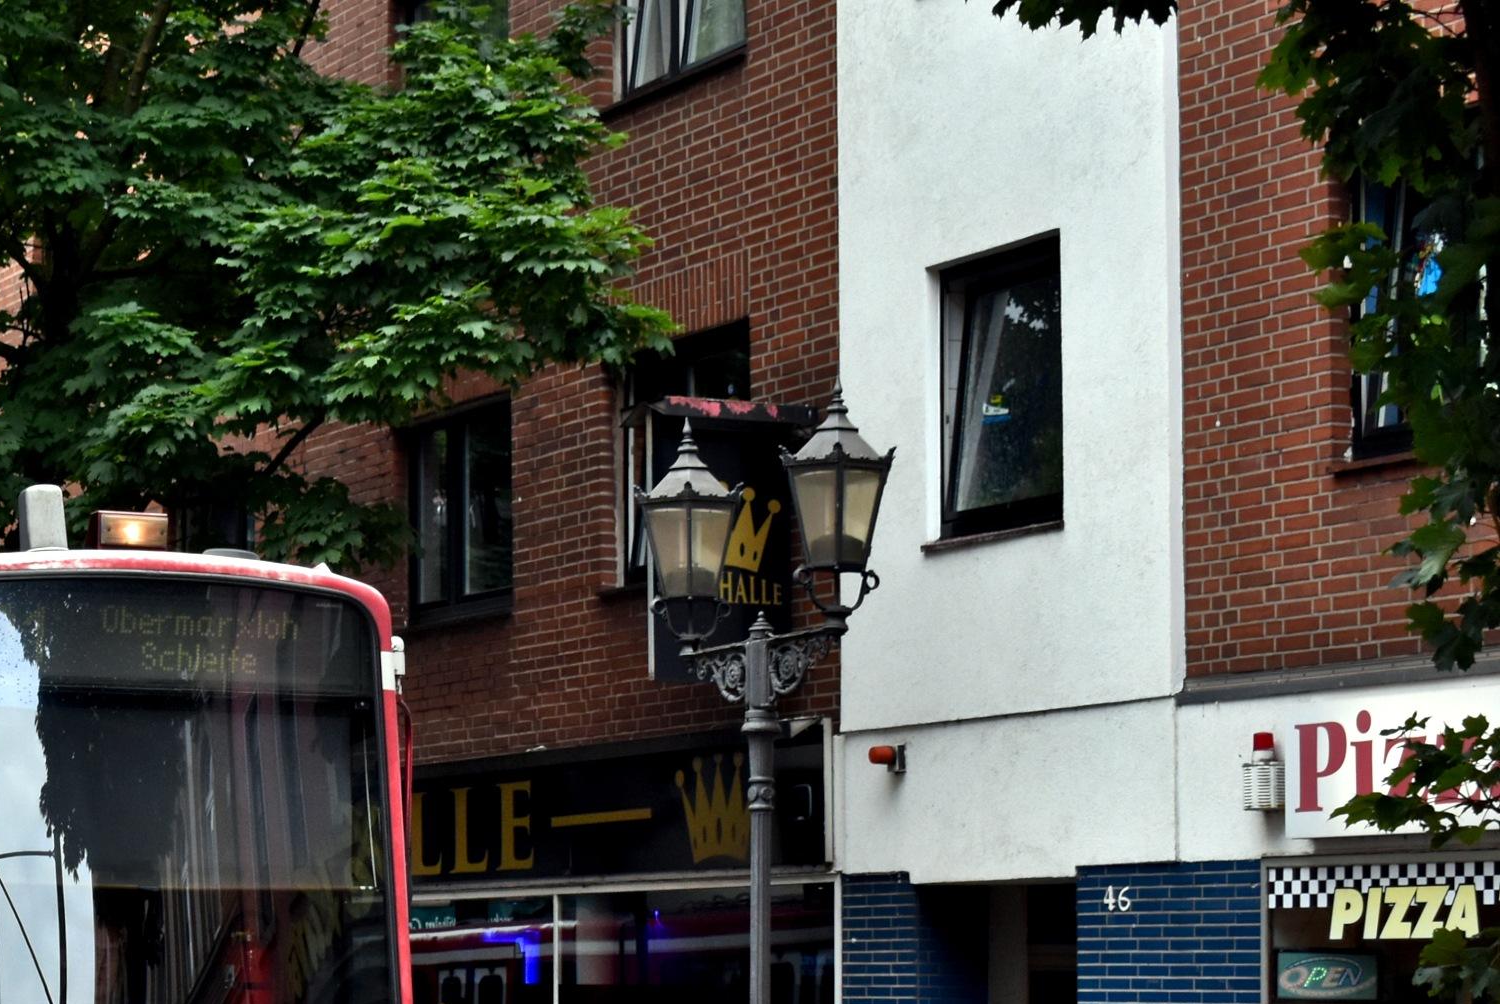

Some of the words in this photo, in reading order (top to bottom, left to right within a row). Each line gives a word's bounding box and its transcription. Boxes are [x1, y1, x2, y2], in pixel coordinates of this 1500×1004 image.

[720, 571, 782, 605] HALLE
[141, 642, 257, 674] Schleife
[1103, 885, 1131, 912] 46
[1329, 884, 1480, 940] PIZZA
[1279, 964, 1363, 990] OPEN
